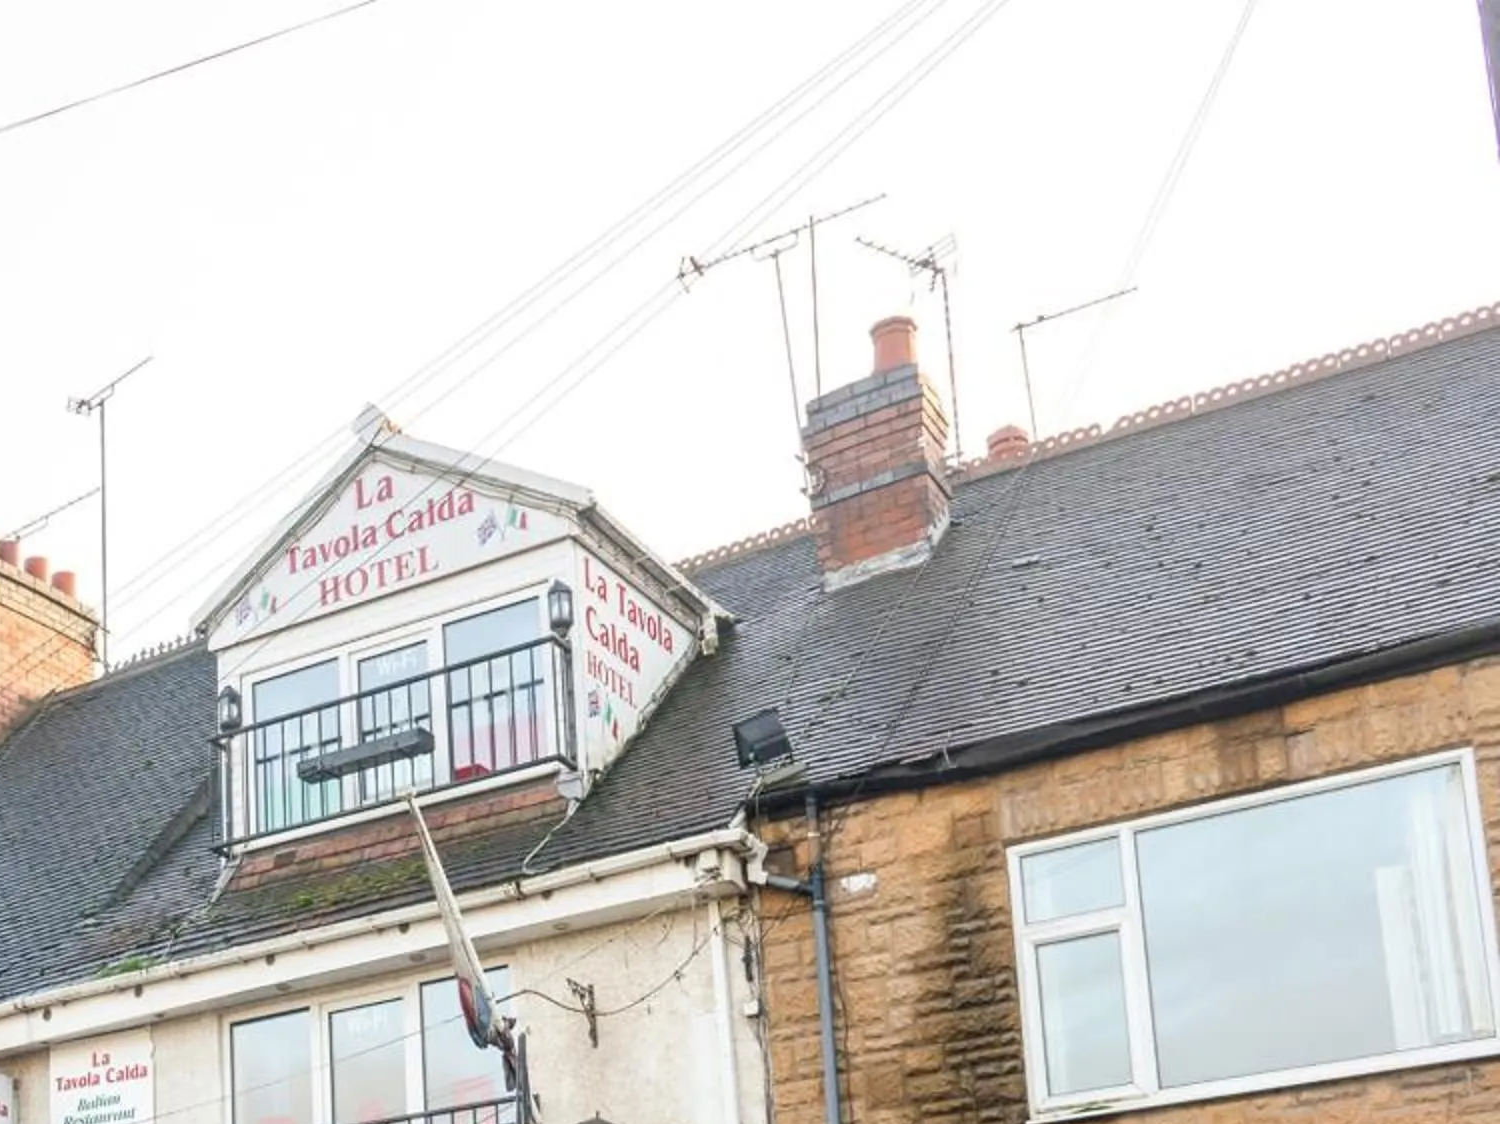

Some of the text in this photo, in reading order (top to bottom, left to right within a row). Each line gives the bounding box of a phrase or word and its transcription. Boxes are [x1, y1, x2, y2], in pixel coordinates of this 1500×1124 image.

[354, 474, 394, 511] La
[285, 487, 476, 575] Tavola Calda
[319, 545, 440, 606] HOTEL
[584, 557, 674, 653] La Tavola
[585, 605, 640, 672] Calda
[587, 649, 638, 709] HOTEL
[55, 1063, 149, 1092] Tavola Calda
[91, 1050, 111, 1068] La
[77, 1092, 121, 1113] Italian
